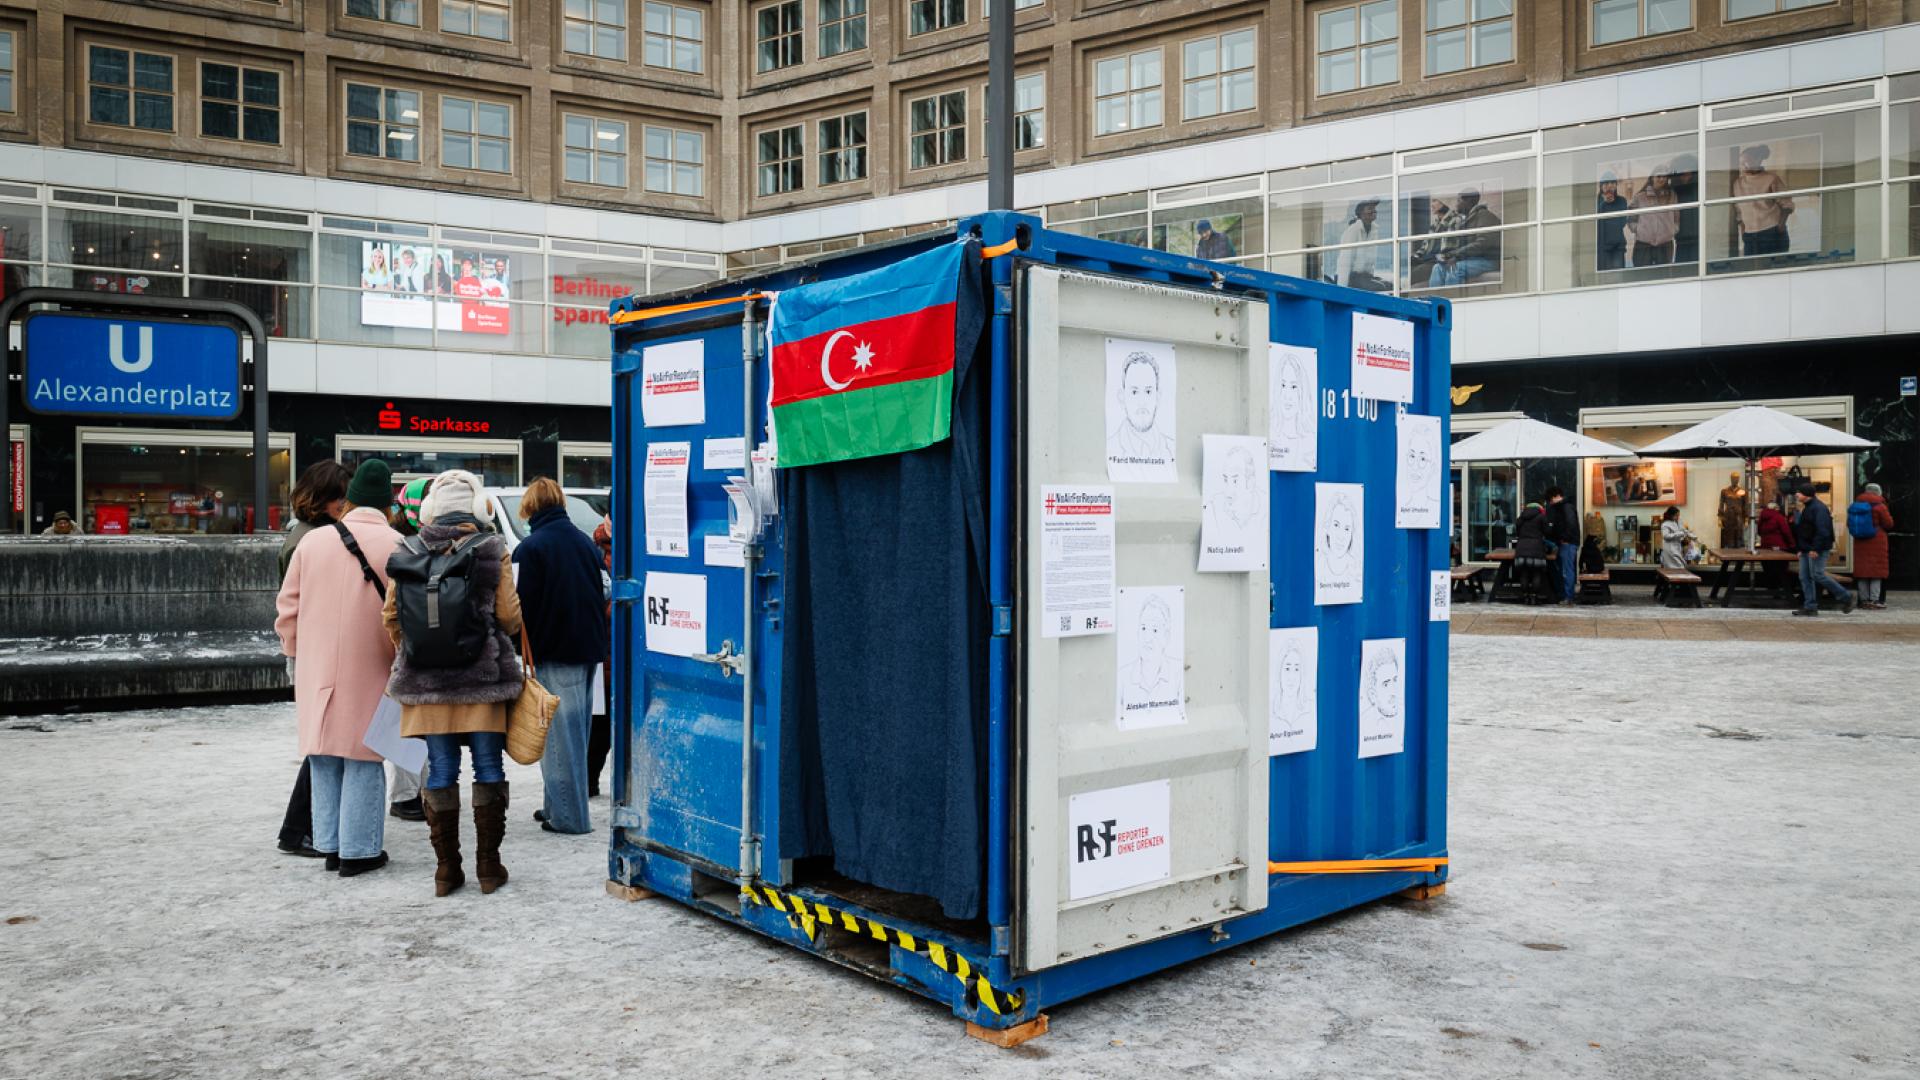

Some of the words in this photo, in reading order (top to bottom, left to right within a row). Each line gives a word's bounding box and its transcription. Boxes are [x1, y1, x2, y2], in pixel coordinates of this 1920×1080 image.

[553, 275, 632, 298] Berliner
[109, 324, 153, 373] U
[34, 378, 231, 410] Alexanderplatz
[409, 415, 490, 433] Sparkasse
[1113, 456, 1129, 464] Farid
[1045, 492, 1111, 515] #NoAirForReporting
[1077, 819, 1117, 864] RSF
[1117, 827, 1149, 843] REPORTER
[1117, 841, 1136, 855] OHNE
[1136, 835, 1164, 850] GRENZEN
